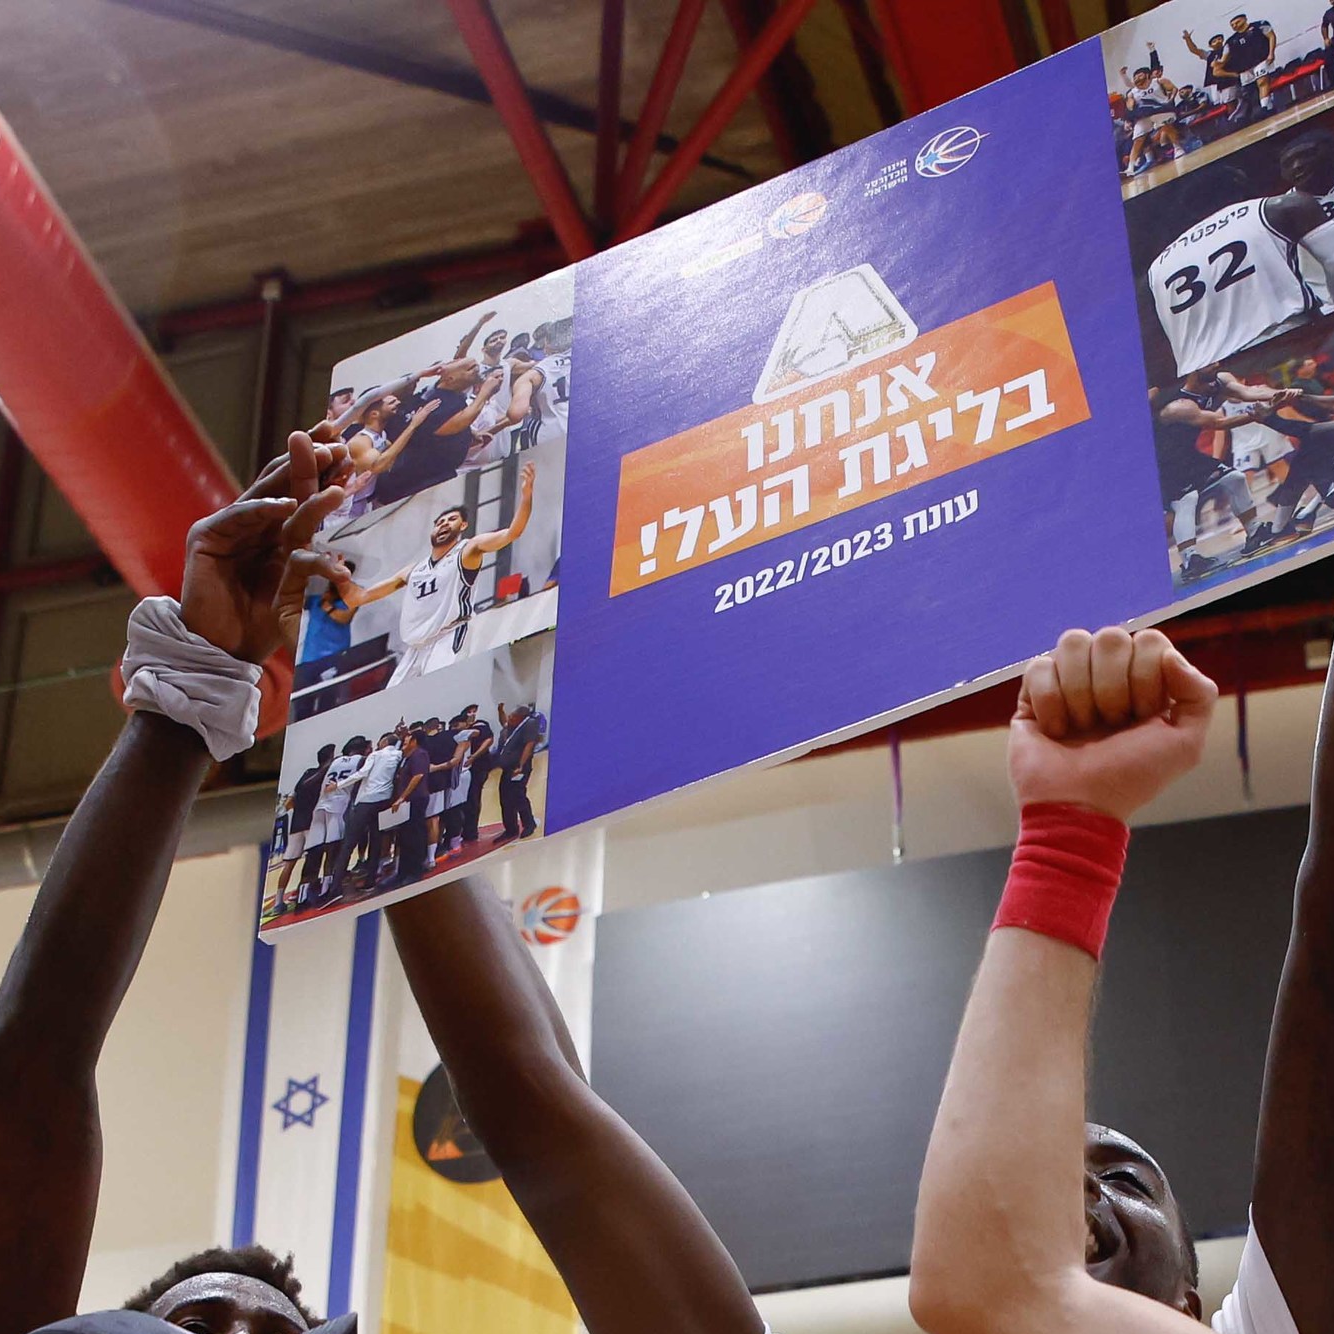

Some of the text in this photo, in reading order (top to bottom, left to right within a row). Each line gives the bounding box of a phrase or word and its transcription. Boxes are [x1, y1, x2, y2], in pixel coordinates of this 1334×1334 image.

[1164, 239, 1256, 315] 32
[638, 369, 1056, 577] בליגת העל!
[740, 352, 940, 473] אנחנו
[416, 578, 439, 601] 11
[713, 489, 980, 614] עונת 2022/2023
